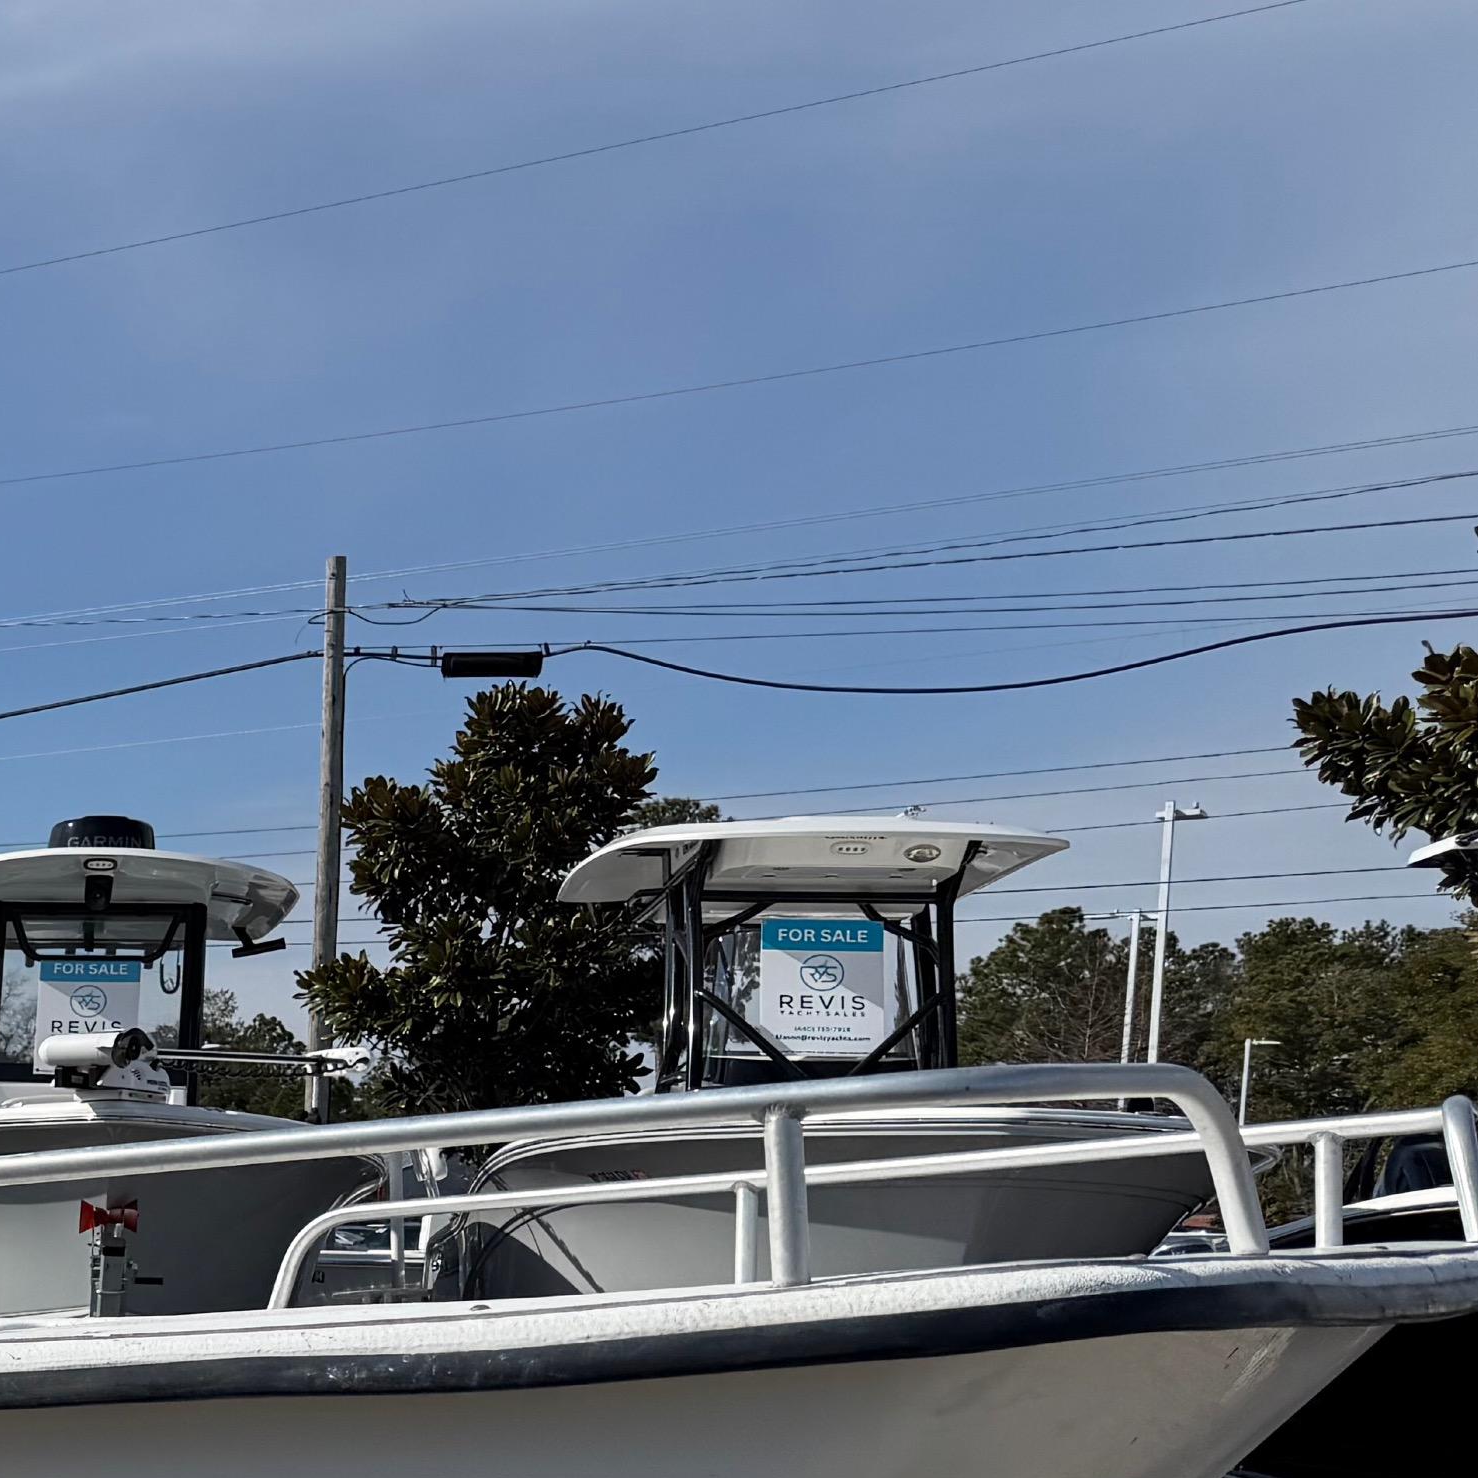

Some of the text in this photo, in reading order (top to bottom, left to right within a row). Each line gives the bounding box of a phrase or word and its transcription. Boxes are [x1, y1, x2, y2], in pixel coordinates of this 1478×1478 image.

[67, 836, 142, 848] GARMIN
[777, 928, 869, 943] FOR SALE
[53, 962, 129, 976] FOR SALE
[779, 994, 866, 1011] REVIS
[51, 1020, 123, 1034] REVIS
